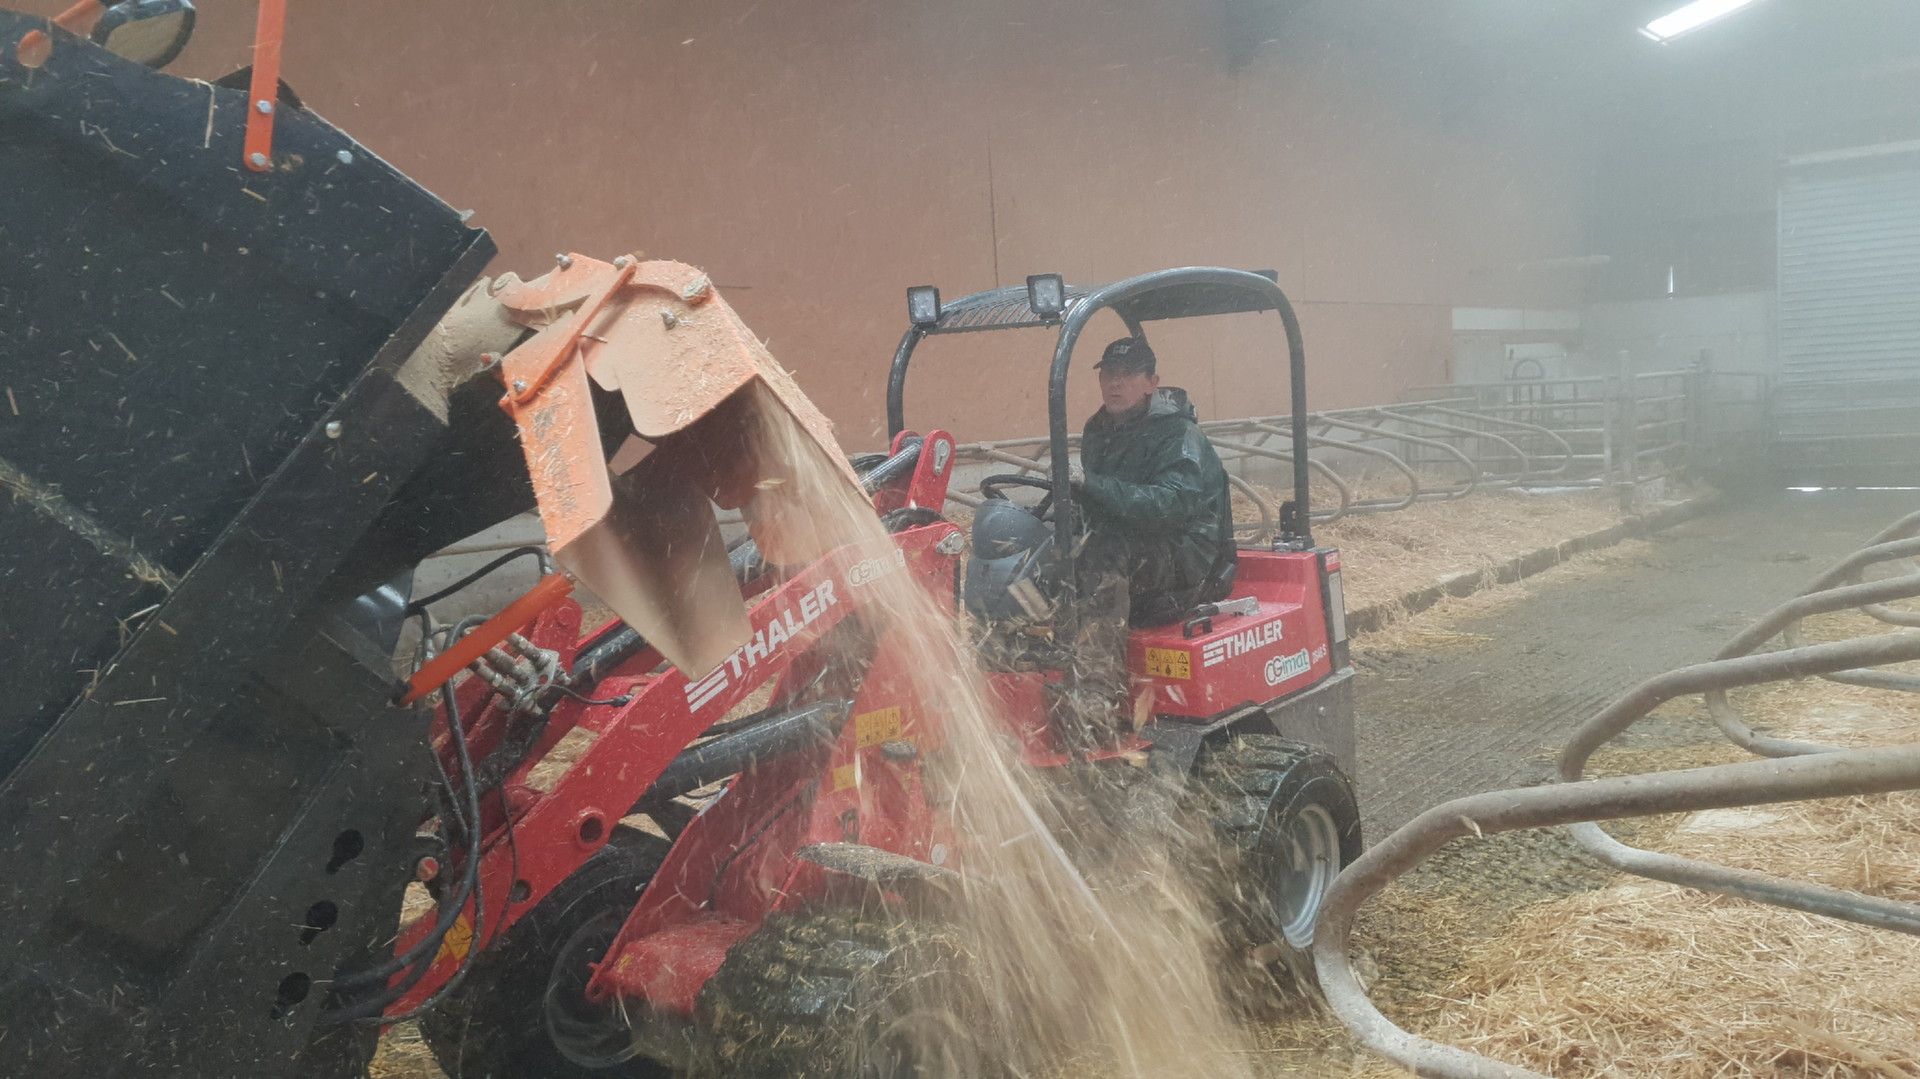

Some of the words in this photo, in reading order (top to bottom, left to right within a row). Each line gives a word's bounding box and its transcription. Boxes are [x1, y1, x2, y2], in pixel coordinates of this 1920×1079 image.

[725, 580, 837, 679] THALER
[1224, 619, 1283, 659] THALER
[1266, 649, 1309, 683] CGimat
